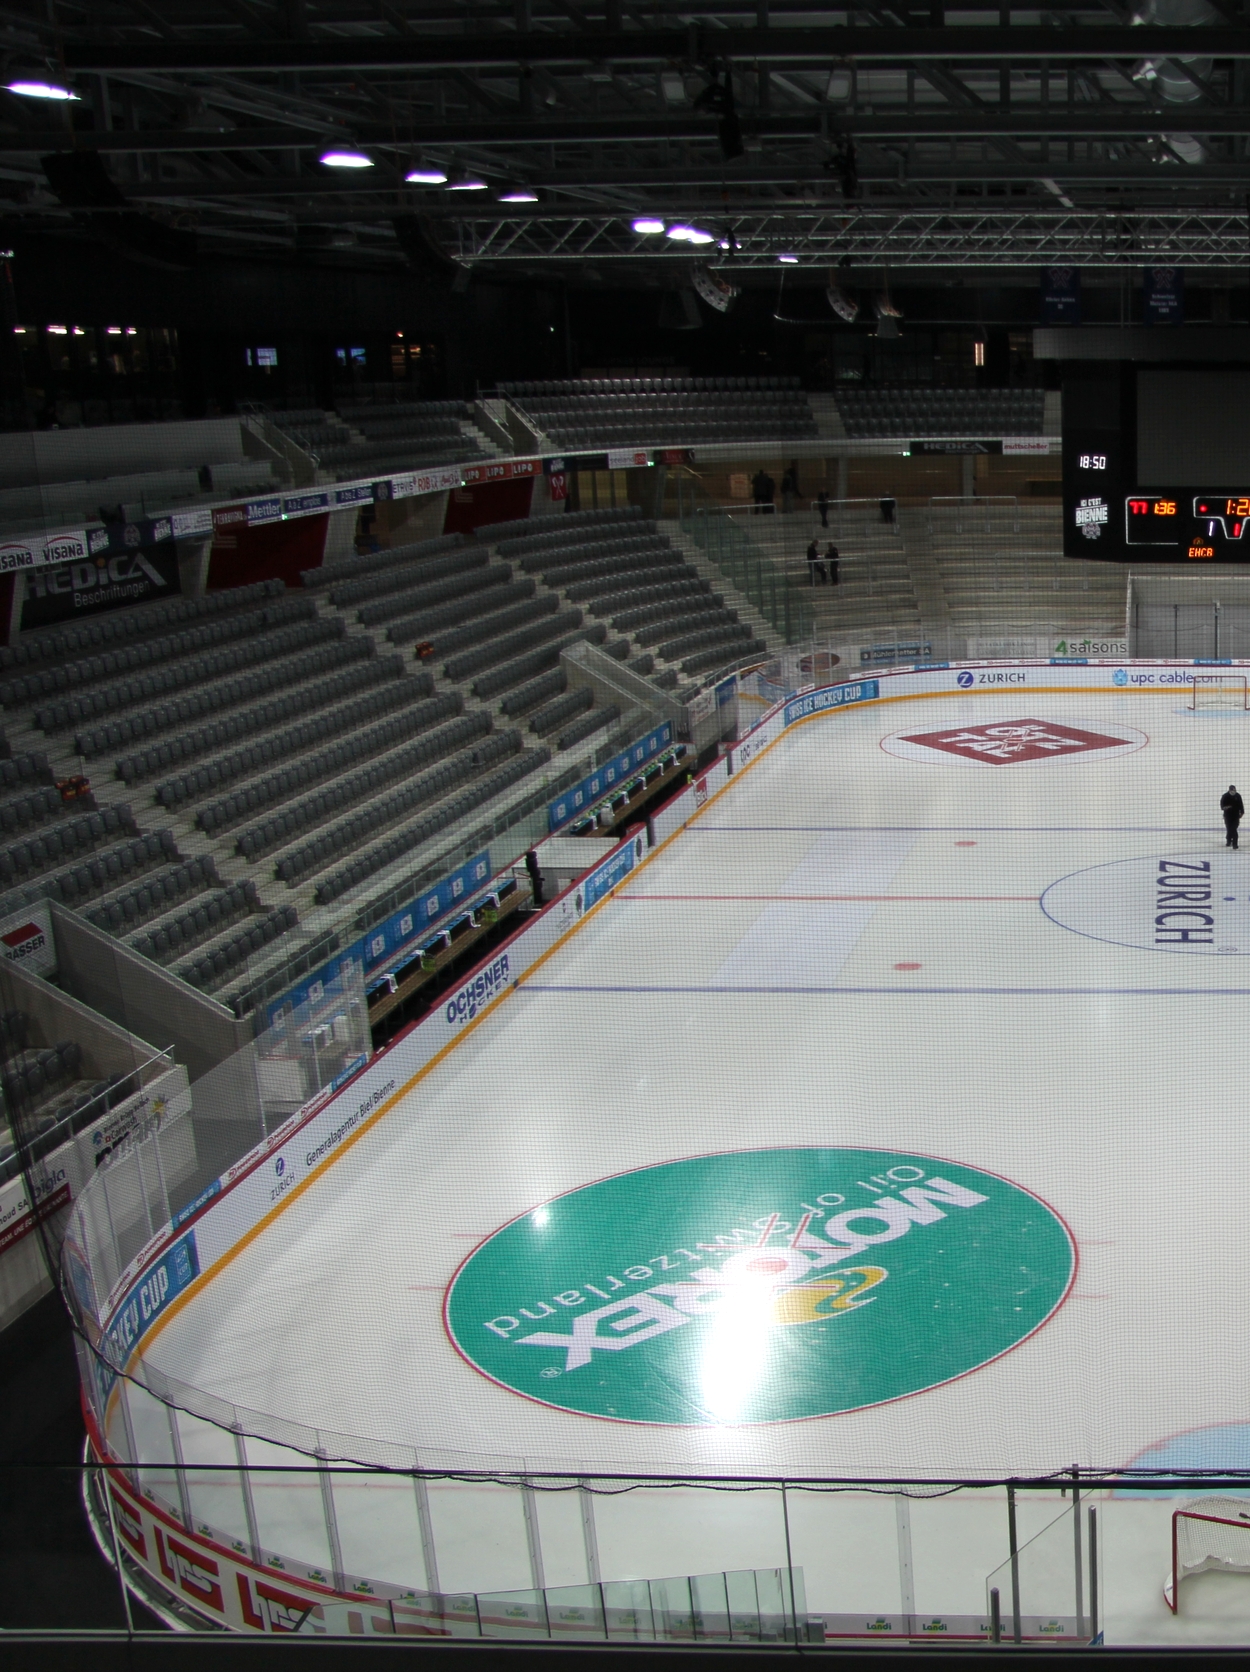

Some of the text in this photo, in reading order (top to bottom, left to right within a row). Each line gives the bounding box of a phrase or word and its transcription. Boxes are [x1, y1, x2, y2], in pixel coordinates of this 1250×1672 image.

[513, 463, 534, 474] LIPO
[1079, 456, 1106, 470] 18:50
[487, 466, 505, 477] LIPO
[248, 502, 282, 520] Mettler
[1129, 501, 1148, 515] 77
[1075, 506, 1109, 524] BIENNE
[1188, 547, 1214, 559] EHCB
[74, 578, 151, 608] Beschriftungen
[979, 672, 1026, 685] ZURICH
[1131, 670, 1223, 687] upc cablecom
[803, 699, 814, 714] ICE
[814, 691, 843, 711] HOCKEY
[844, 685, 862, 701] CUP
[1154, 859, 1215, 945] ZURICH
[447, 954, 509, 1024] OCHSNER
[306, 1079, 396, 1167] Generalagentur Biel/Bienne
[270, 1171, 296, 1201] ZURICH
[17, 1199, 29, 1212] SA
[482, 1164, 927, 1338] Oil of Switzerland
[140, 1265, 169, 1321] CUP
[267, 1557, 285, 1570] Landi
[307, 1572, 328, 1584] Landi
[353, 1584, 374, 1595] Landi
[505, 1608, 529, 1619] Landi
[559, 1611, 585, 1622] Landi
[866, 1621, 892, 1631] Landi
[922, 1622, 948, 1632] Landi
[1039, 1623, 1065, 1633] Landi
